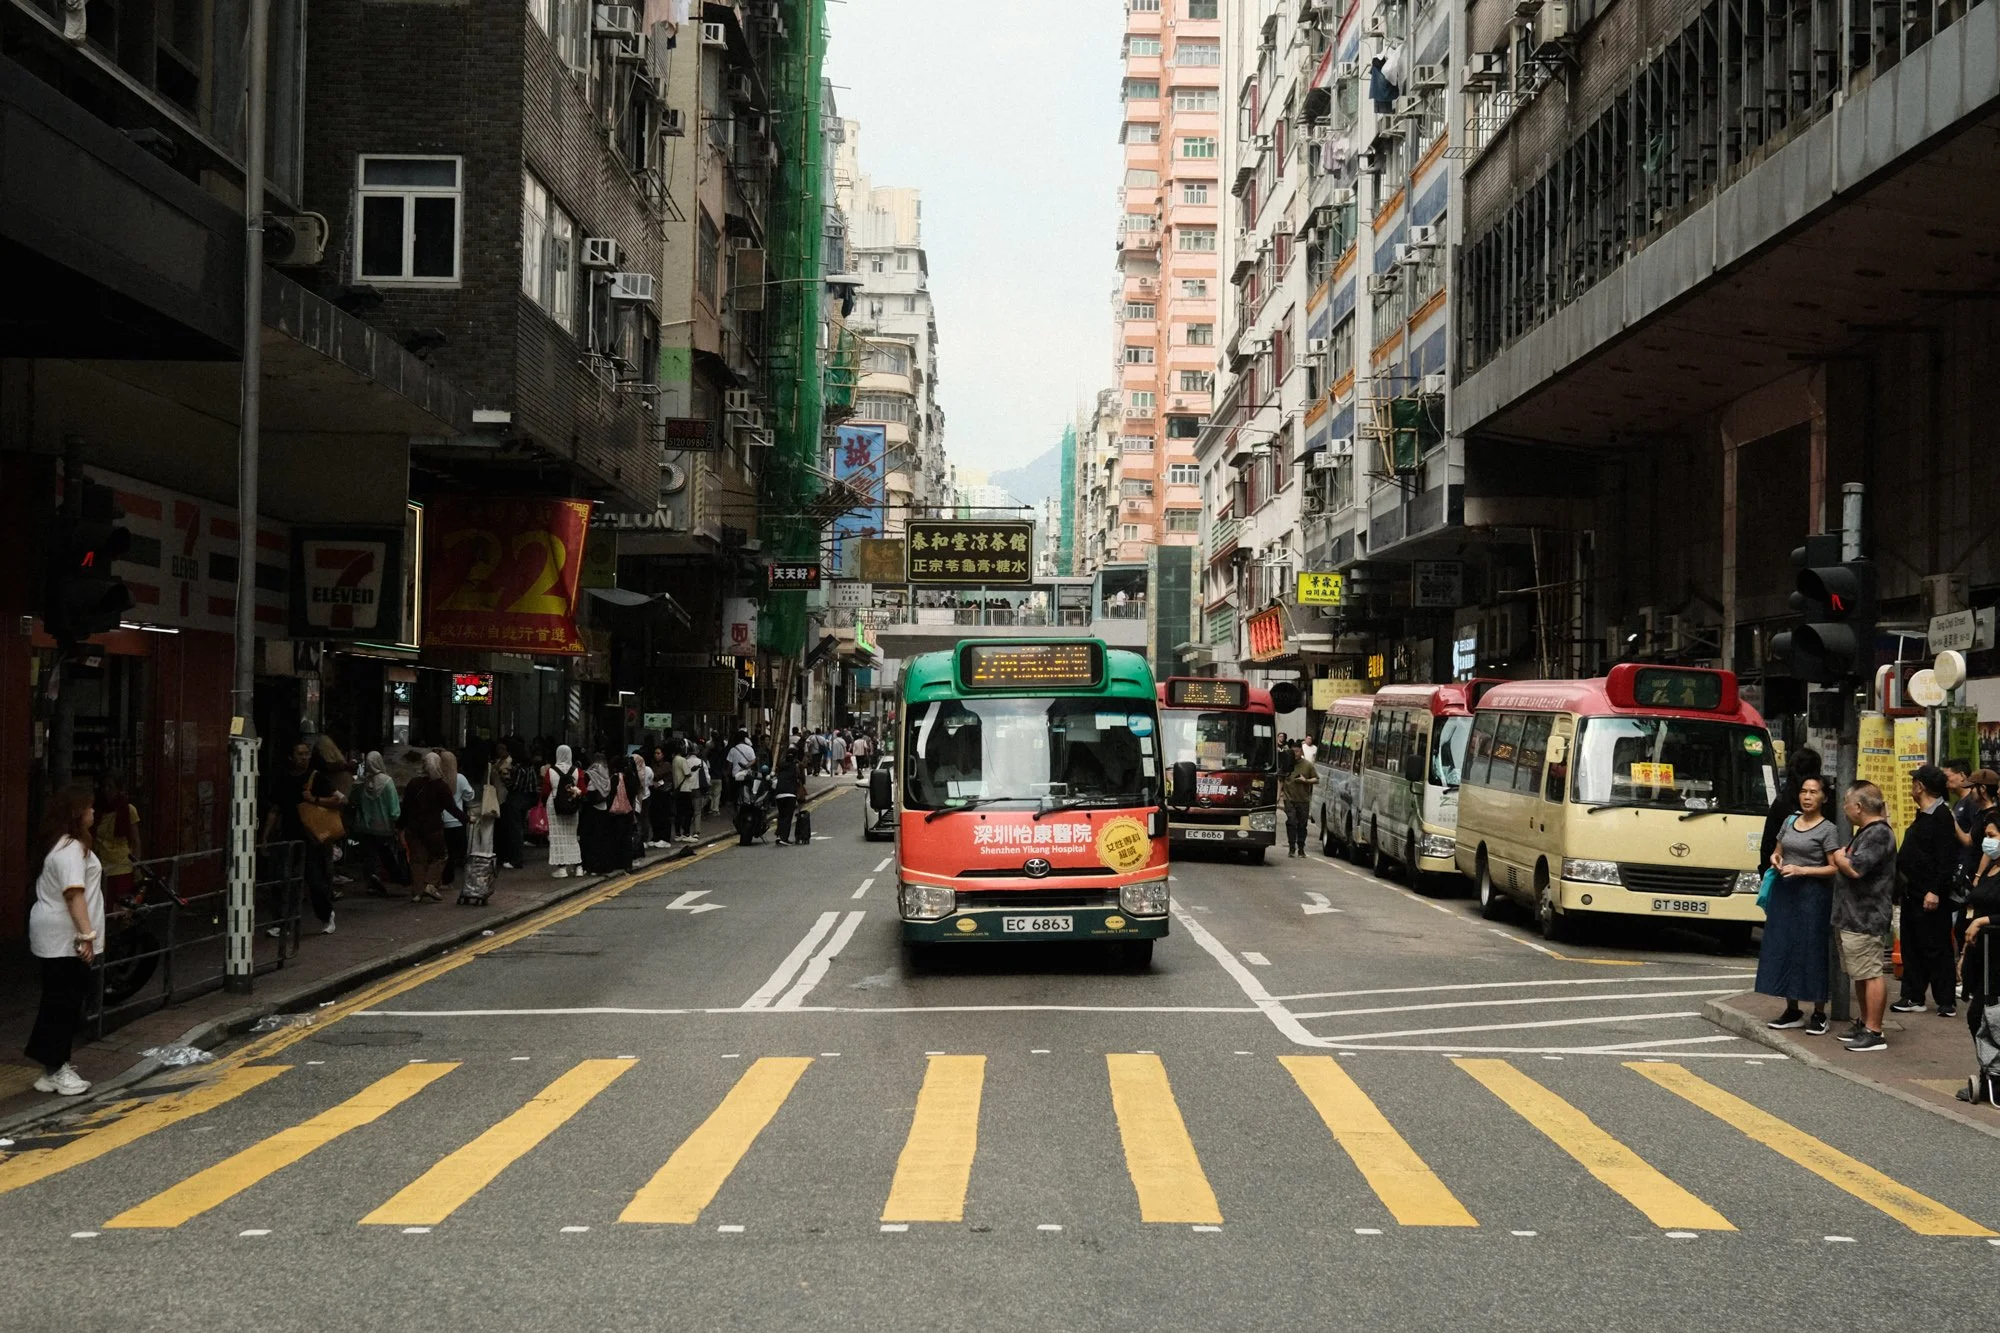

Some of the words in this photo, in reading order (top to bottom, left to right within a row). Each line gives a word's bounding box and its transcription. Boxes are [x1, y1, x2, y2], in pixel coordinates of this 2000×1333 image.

[436, 528, 567, 616] 22
[774, 568, 808, 579] 天天好
[974, 824, 1092, 845] 深圳怡康醫院
[980, 846, 1020, 855] Shenzhen
[1022, 845, 1050, 855] Yikang
[1051, 844, 1086, 854] Hospital
[1653, 900, 1670, 910] GT
[1673, 901, 1707, 912] 9883
[1006, 919, 1026, 931] EC
[1033, 918, 1071, 930] 6863
